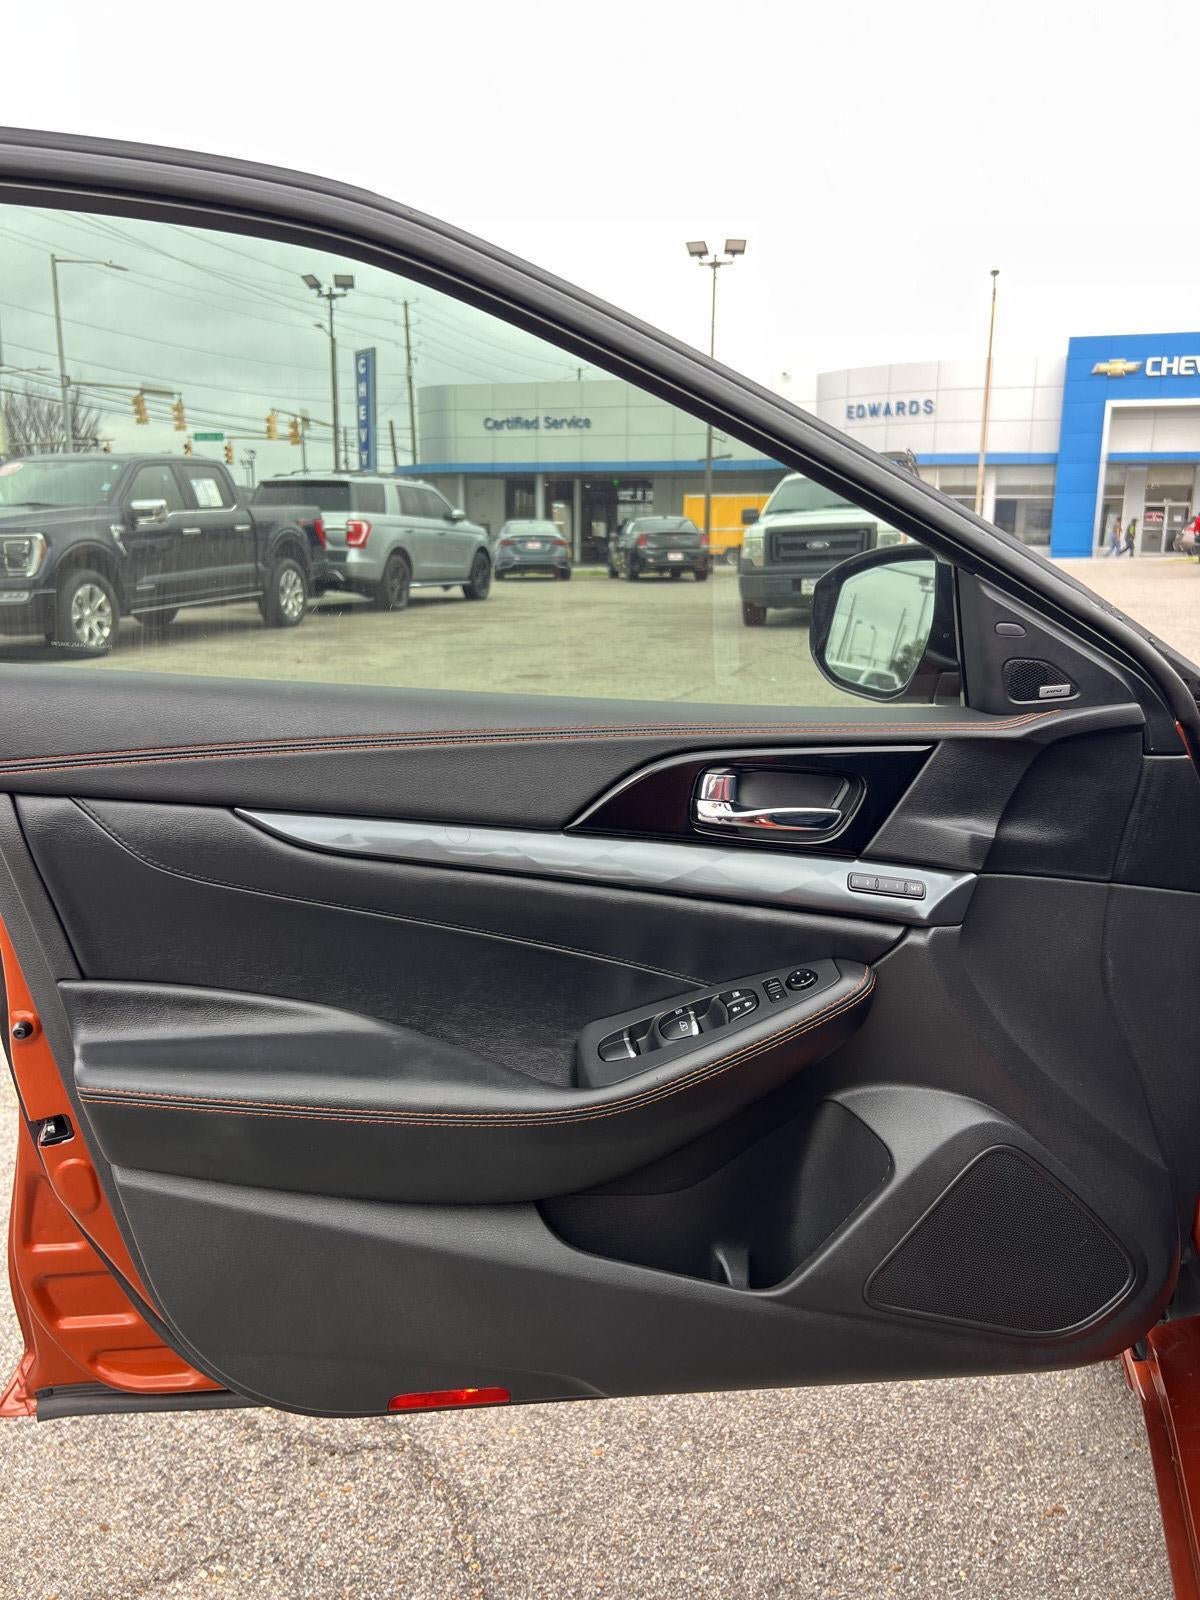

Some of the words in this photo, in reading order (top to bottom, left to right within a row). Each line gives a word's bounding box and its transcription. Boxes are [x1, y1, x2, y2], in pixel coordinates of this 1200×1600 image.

[358, 358, 368, 466] CHEVY
[846, 399, 934, 420] EDWARDS
[483, 416, 540, 430] Certified
[543, 416, 592, 429] Service
